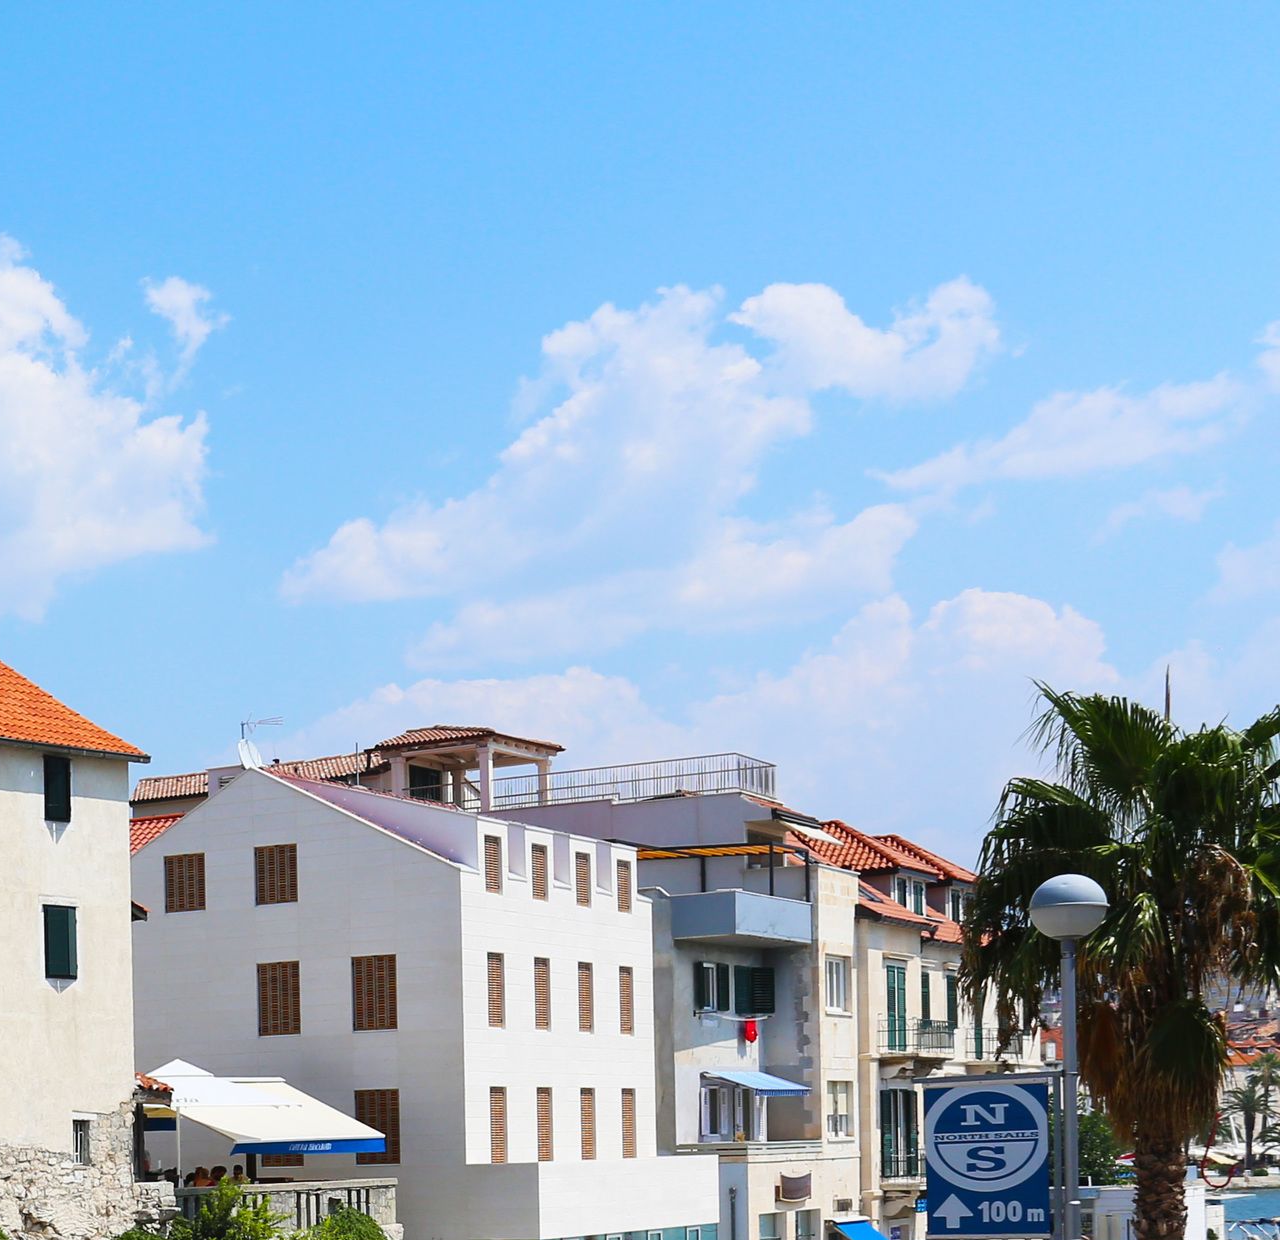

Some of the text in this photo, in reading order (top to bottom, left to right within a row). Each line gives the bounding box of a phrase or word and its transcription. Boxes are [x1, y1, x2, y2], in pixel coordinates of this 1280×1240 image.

[960, 1103, 1009, 1126] N
[934, 1131, 1040, 1142] NORTH SAILS
[966, 1146, 1007, 1173] S
[977, 1200, 1045, 1223] 100 m
